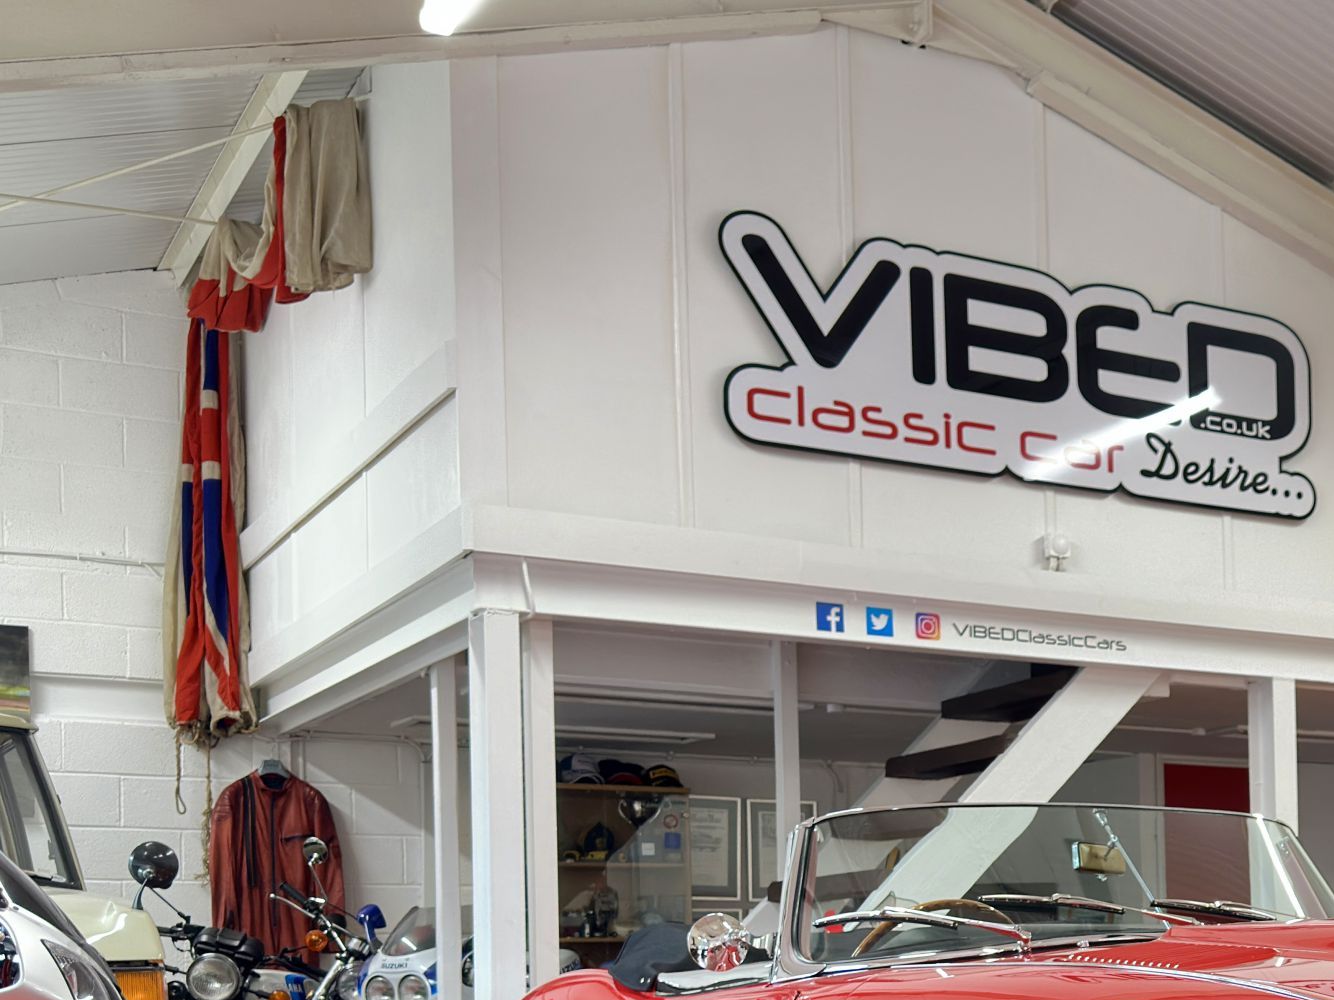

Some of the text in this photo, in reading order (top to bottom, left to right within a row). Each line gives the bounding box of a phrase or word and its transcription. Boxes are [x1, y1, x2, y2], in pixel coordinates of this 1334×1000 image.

[741, 232, 1295, 441] VIBED
[1200, 415, 1271, 439] .co.uk
[746, 385, 1303, 500] classic car Desire...
[952, 622, 1127, 651] VIBEDClassicCars
[381, 962, 408, 970] SUZUKI
